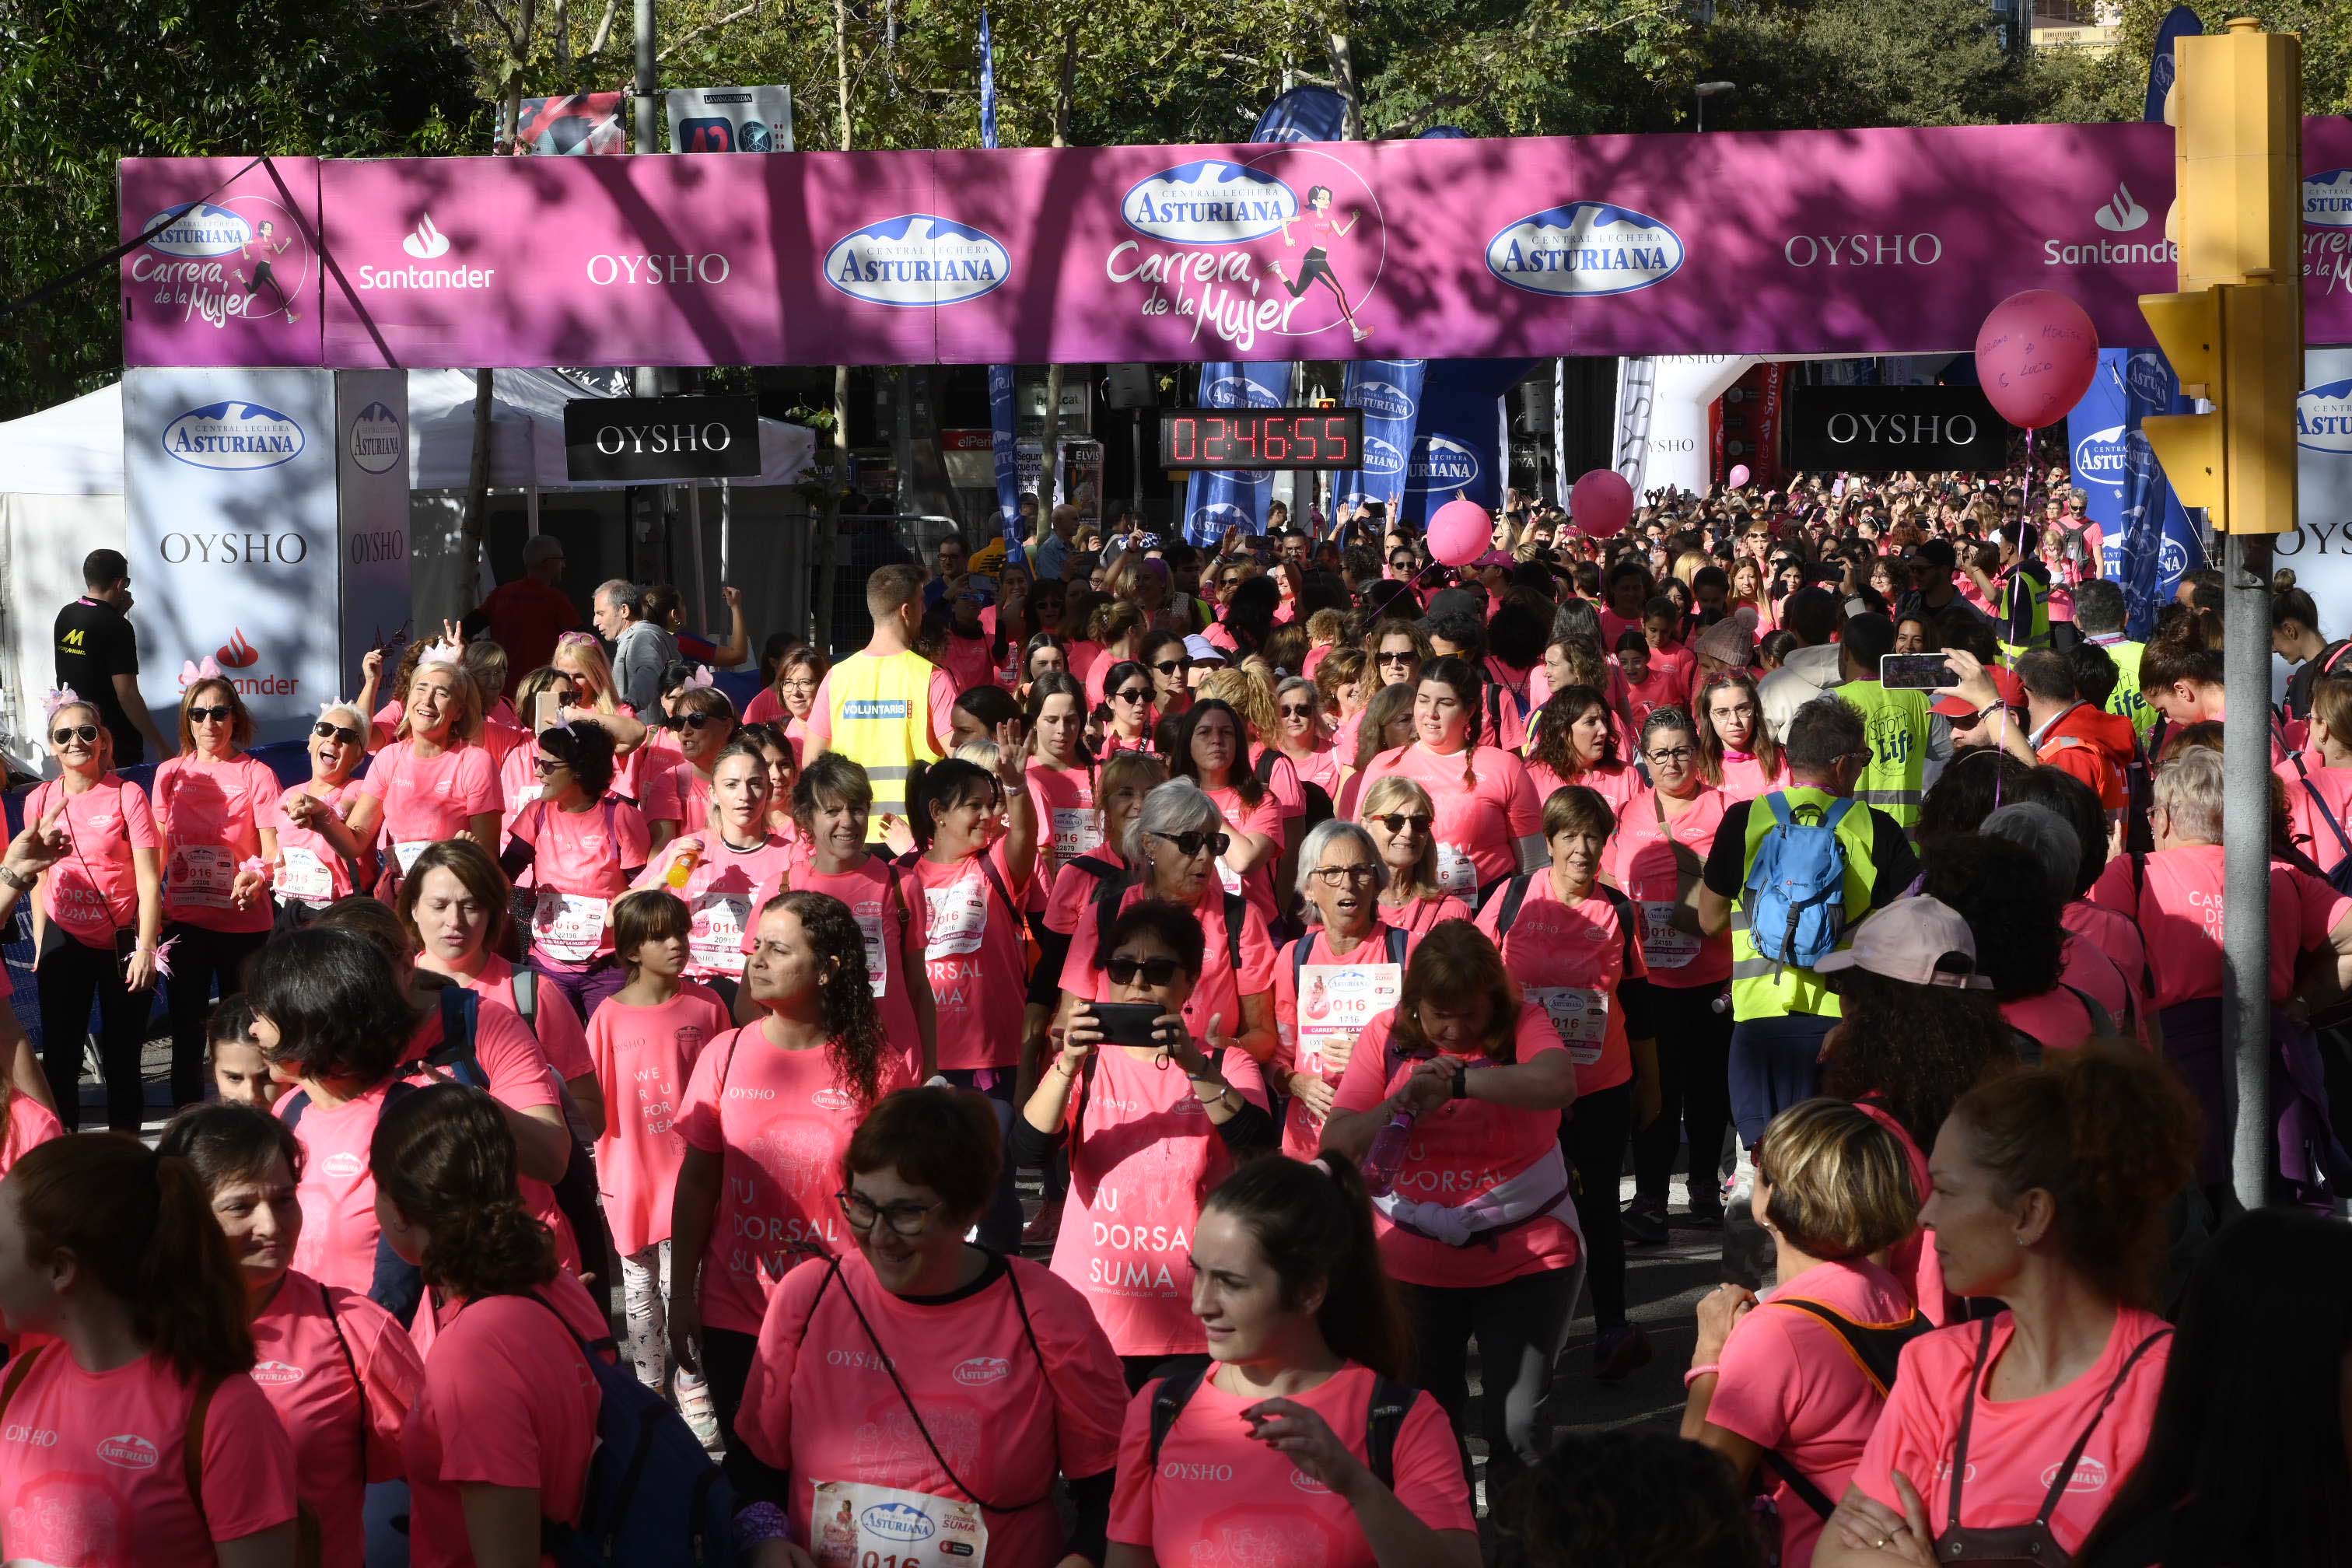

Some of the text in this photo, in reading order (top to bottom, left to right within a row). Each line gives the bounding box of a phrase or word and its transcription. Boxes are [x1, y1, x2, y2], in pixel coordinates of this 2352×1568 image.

[1161, 188, 1279, 198] CENTRAL LECHERA
[1134, 191, 1285, 224] ASTURIANA
[2303, 198, 2352, 213] STUR
[866, 245, 990, 255] CENTRAL LECHERA
[1531, 233, 1662, 245] CENTRAL LECHERA
[1785, 233, 1943, 268] OYSHO
[2303, 231, 2352, 254] rre
[1106, 240, 1251, 285] Carrera
[1500, 237, 1670, 274] ASTURIANA
[2043, 238, 2179, 265] Santande
[131, 254, 223, 282] Carrera
[587, 254, 730, 285] OYSHO
[838, 248, 996, 282] ASTURIANA
[2303, 253, 2352, 297] e la M
[359, 264, 495, 290] Santander
[154, 278, 258, 328] de la Mujer
[1142, 277, 1305, 352] de la Mujer
[194, 424, 240, 432] CENTRAL
[1826, 412, 1979, 446] OYSHO
[2297, 406, 2352, 436] ASTU
[172, 425, 295, 455] ASTURIANA
[354, 429, 402, 457] ASTURIANA
[596, 422, 731, 455] OYSHO
[957, 435, 992, 448] elPeri
[1173, 417, 1347, 460] 02:46:55
[1647, 439, 1694, 453] YSHO
[1076, 450, 1099, 460] ELVIS
[2081, 447, 2126, 470] ASTU
[1017, 473, 1042, 484] quiere
[1407, 462, 1472, 478] URIANA
[160, 531, 308, 565] OYSHO
[352, 529, 404, 565] OYSHO
[844, 703, 905, 715] VOLUNTARIS
[2110, 688, 2154, 719] ife
[1869, 711, 1909, 741] Sport
[1878, 729, 1916, 764] Life
[1054, 834, 1078, 844] 016
[189, 867, 212, 877] 016
[1440, 870, 1450, 880] 6
[2188, 891, 2224, 910] CAR
[712, 922, 740, 933] 016
[1650, 927, 1676, 938] 016
[925, 959, 983, 982] ORSAL
[1332, 999, 1367, 1012] 016
[1338, 1015, 1360, 1024] 1716
[634, 1066, 661, 1083] WE
[638, 1082, 673, 1101] R U
[729, 1087, 776, 1101] OYSHO
[642, 1103, 672, 1118] FOR
[647, 1120, 674, 1136] REA
[730, 1176, 754, 1205] TU
[733, 1216, 838, 1244] DORSAL
[1093, 1223, 1190, 1251] DORSA
[1090, 1262, 1176, 1289] SUMA
[826, 1349, 895, 1373] OYSHO
[103, 1441, 156, 1464] ASTURIANA
[1164, 1461, 1233, 1482] OYSHO
[865, 1512, 929, 1535] ASTURIANA
[942, 1519, 975, 1532] SUMA
